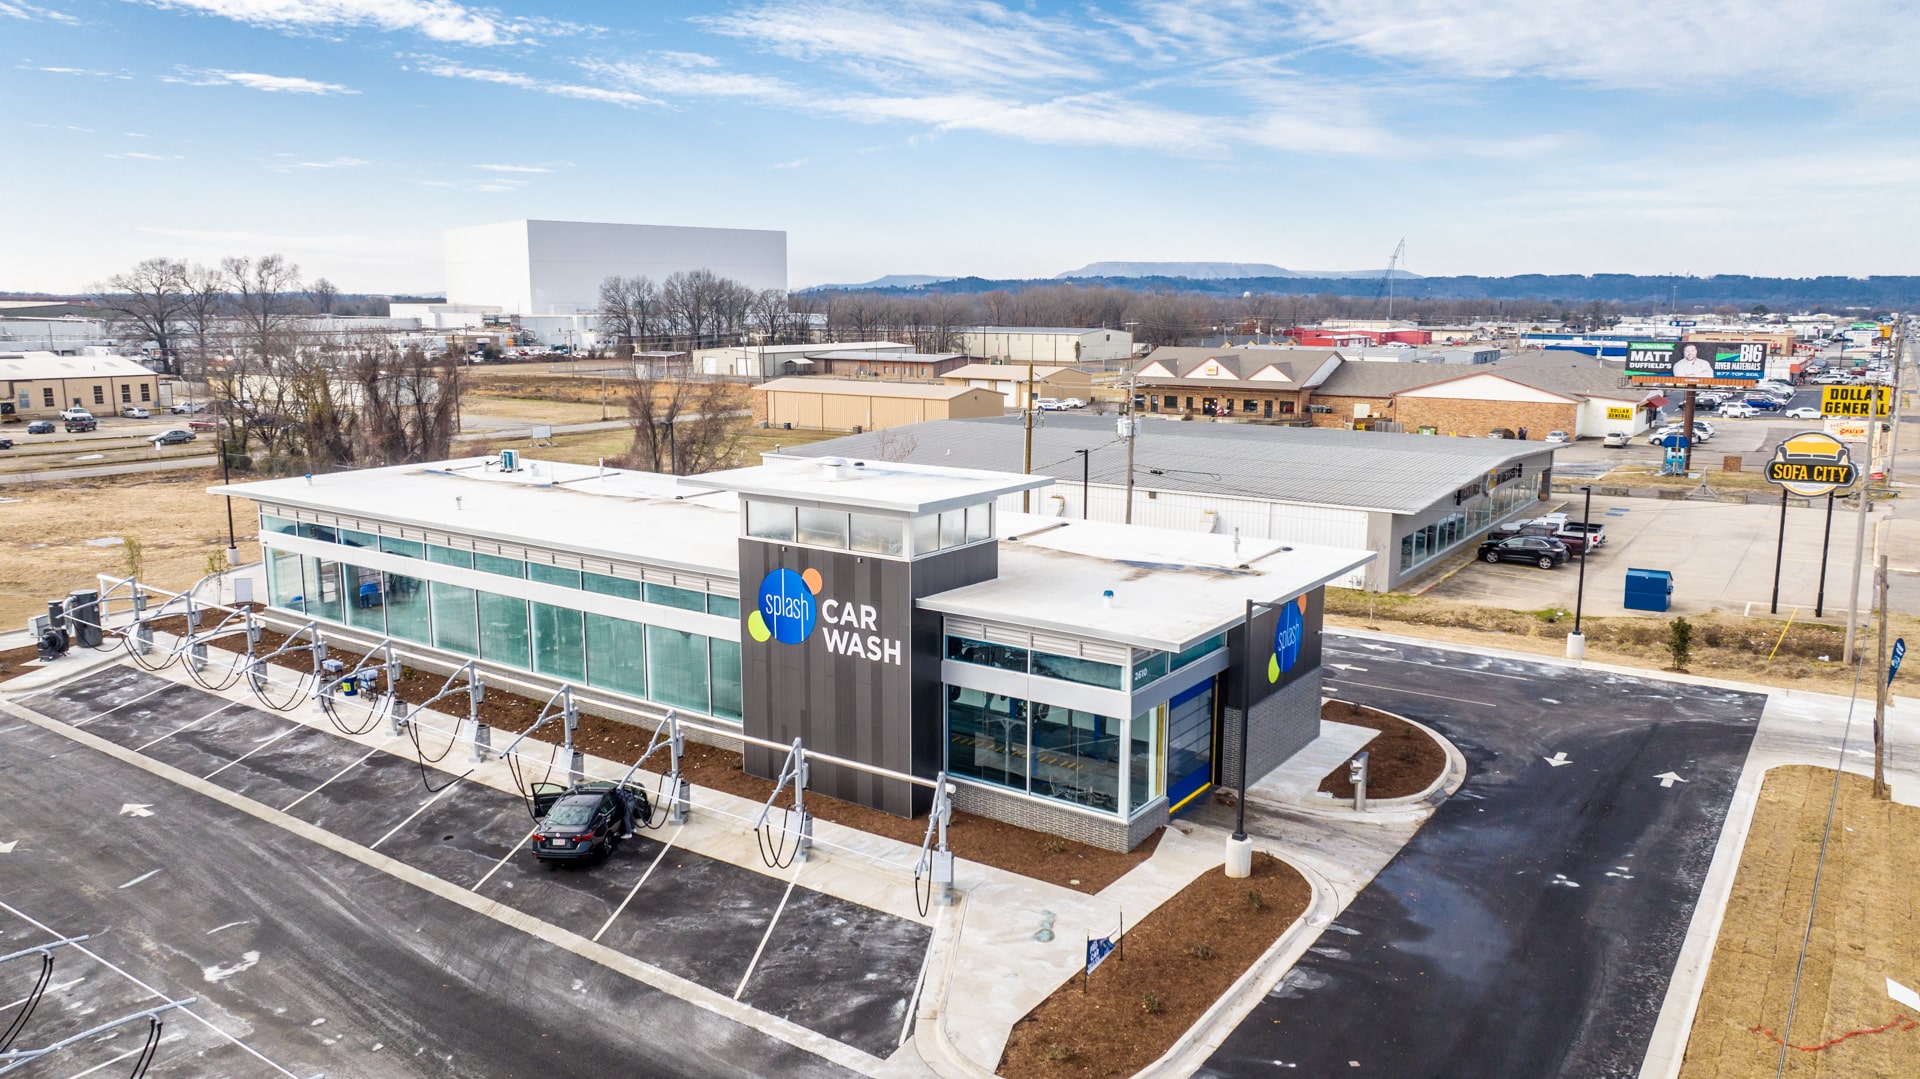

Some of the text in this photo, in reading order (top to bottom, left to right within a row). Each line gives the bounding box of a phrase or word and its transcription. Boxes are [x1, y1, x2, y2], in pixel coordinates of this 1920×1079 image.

[1630, 351, 1672, 362] MATT
[1740, 344, 1763, 362] BIG
[1714, 361, 1761, 371] RIVER MATERIALS
[1830, 388, 1884, 402] DOLLAR
[1773, 464, 1848, 482] SOFA CITY
[822, 599, 878, 631] CAR
[822, 627, 901, 665] WASH
